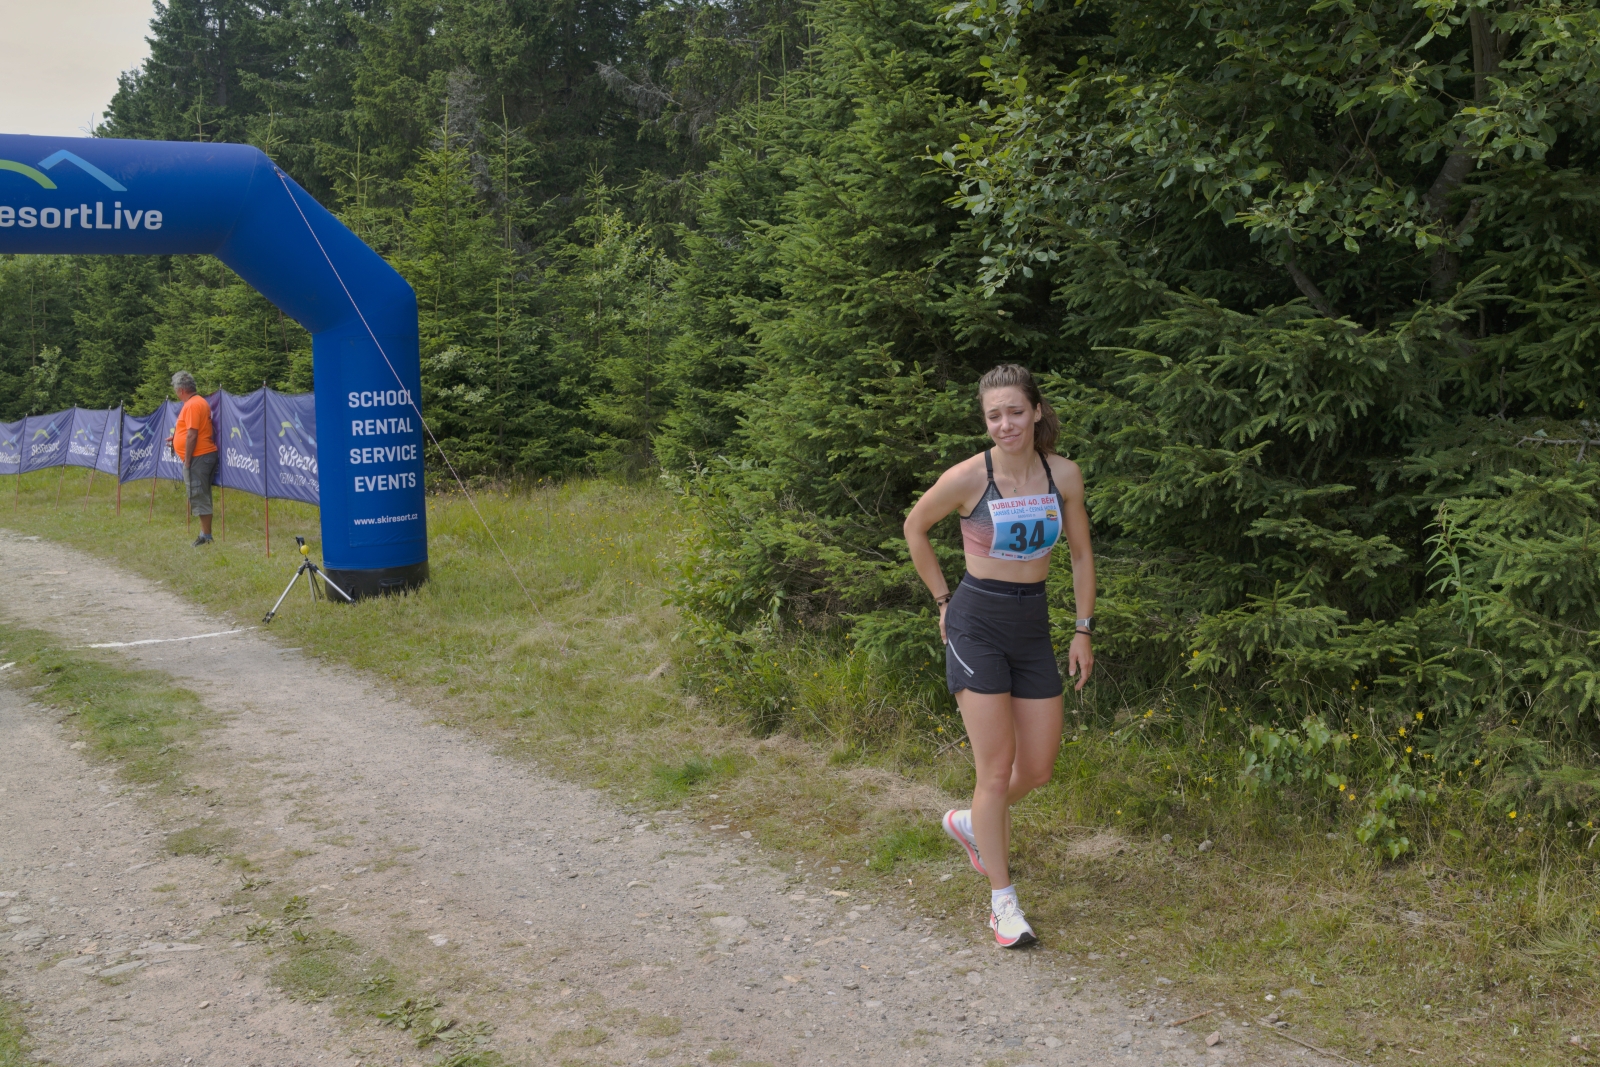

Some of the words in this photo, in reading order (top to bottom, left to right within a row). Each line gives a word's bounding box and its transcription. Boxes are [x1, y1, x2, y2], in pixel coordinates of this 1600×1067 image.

[348, 389, 414, 408] SCHOOL
[351, 417, 414, 436] RENTAL
[349, 444, 417, 465] SERVICE
[354, 471, 416, 493] EVENTS
[992, 498, 1026, 510] JUBILEJNÍ
[1041, 496, 1054, 504] BĚH
[353, 513, 418, 526] www.skiresort.cz
[1009, 520, 1046, 552] 34
